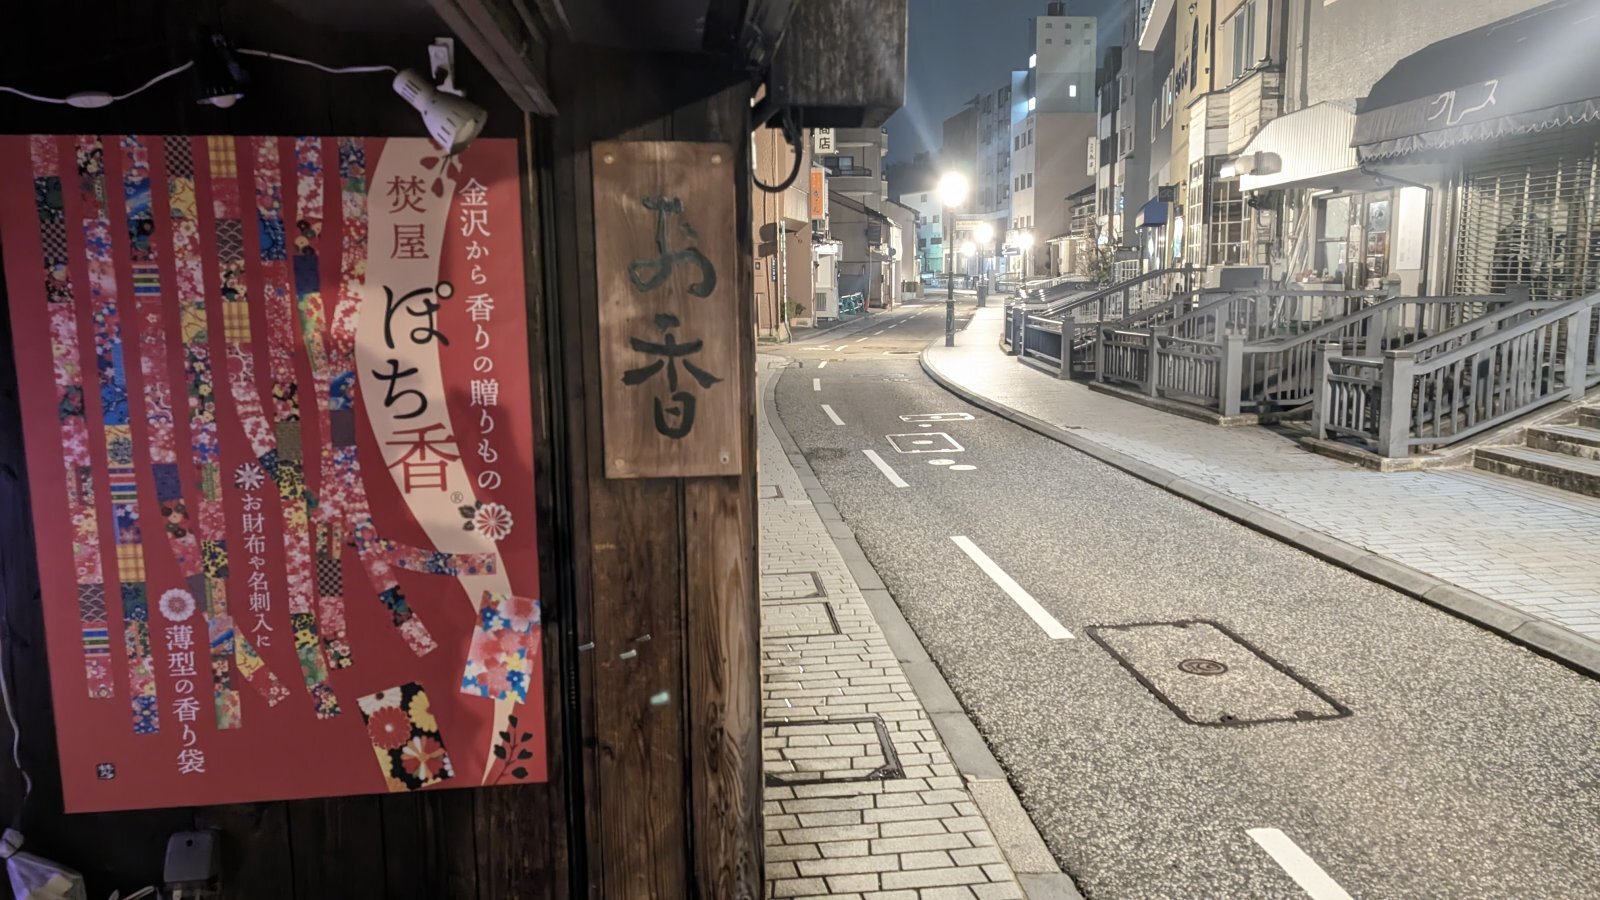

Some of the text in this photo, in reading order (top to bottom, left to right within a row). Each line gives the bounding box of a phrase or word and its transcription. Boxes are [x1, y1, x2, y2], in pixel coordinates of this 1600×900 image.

[386, 175, 430, 260] 焚屋
[371, 280, 462, 495] ぽち香
[458, 177, 502, 491] 金沢から香りの贈りもの
[621, 195, 724, 440] お香
[241, 493, 274, 648] お財布や名刺入に
[164, 624, 206, 775] 薄型の香り袋
